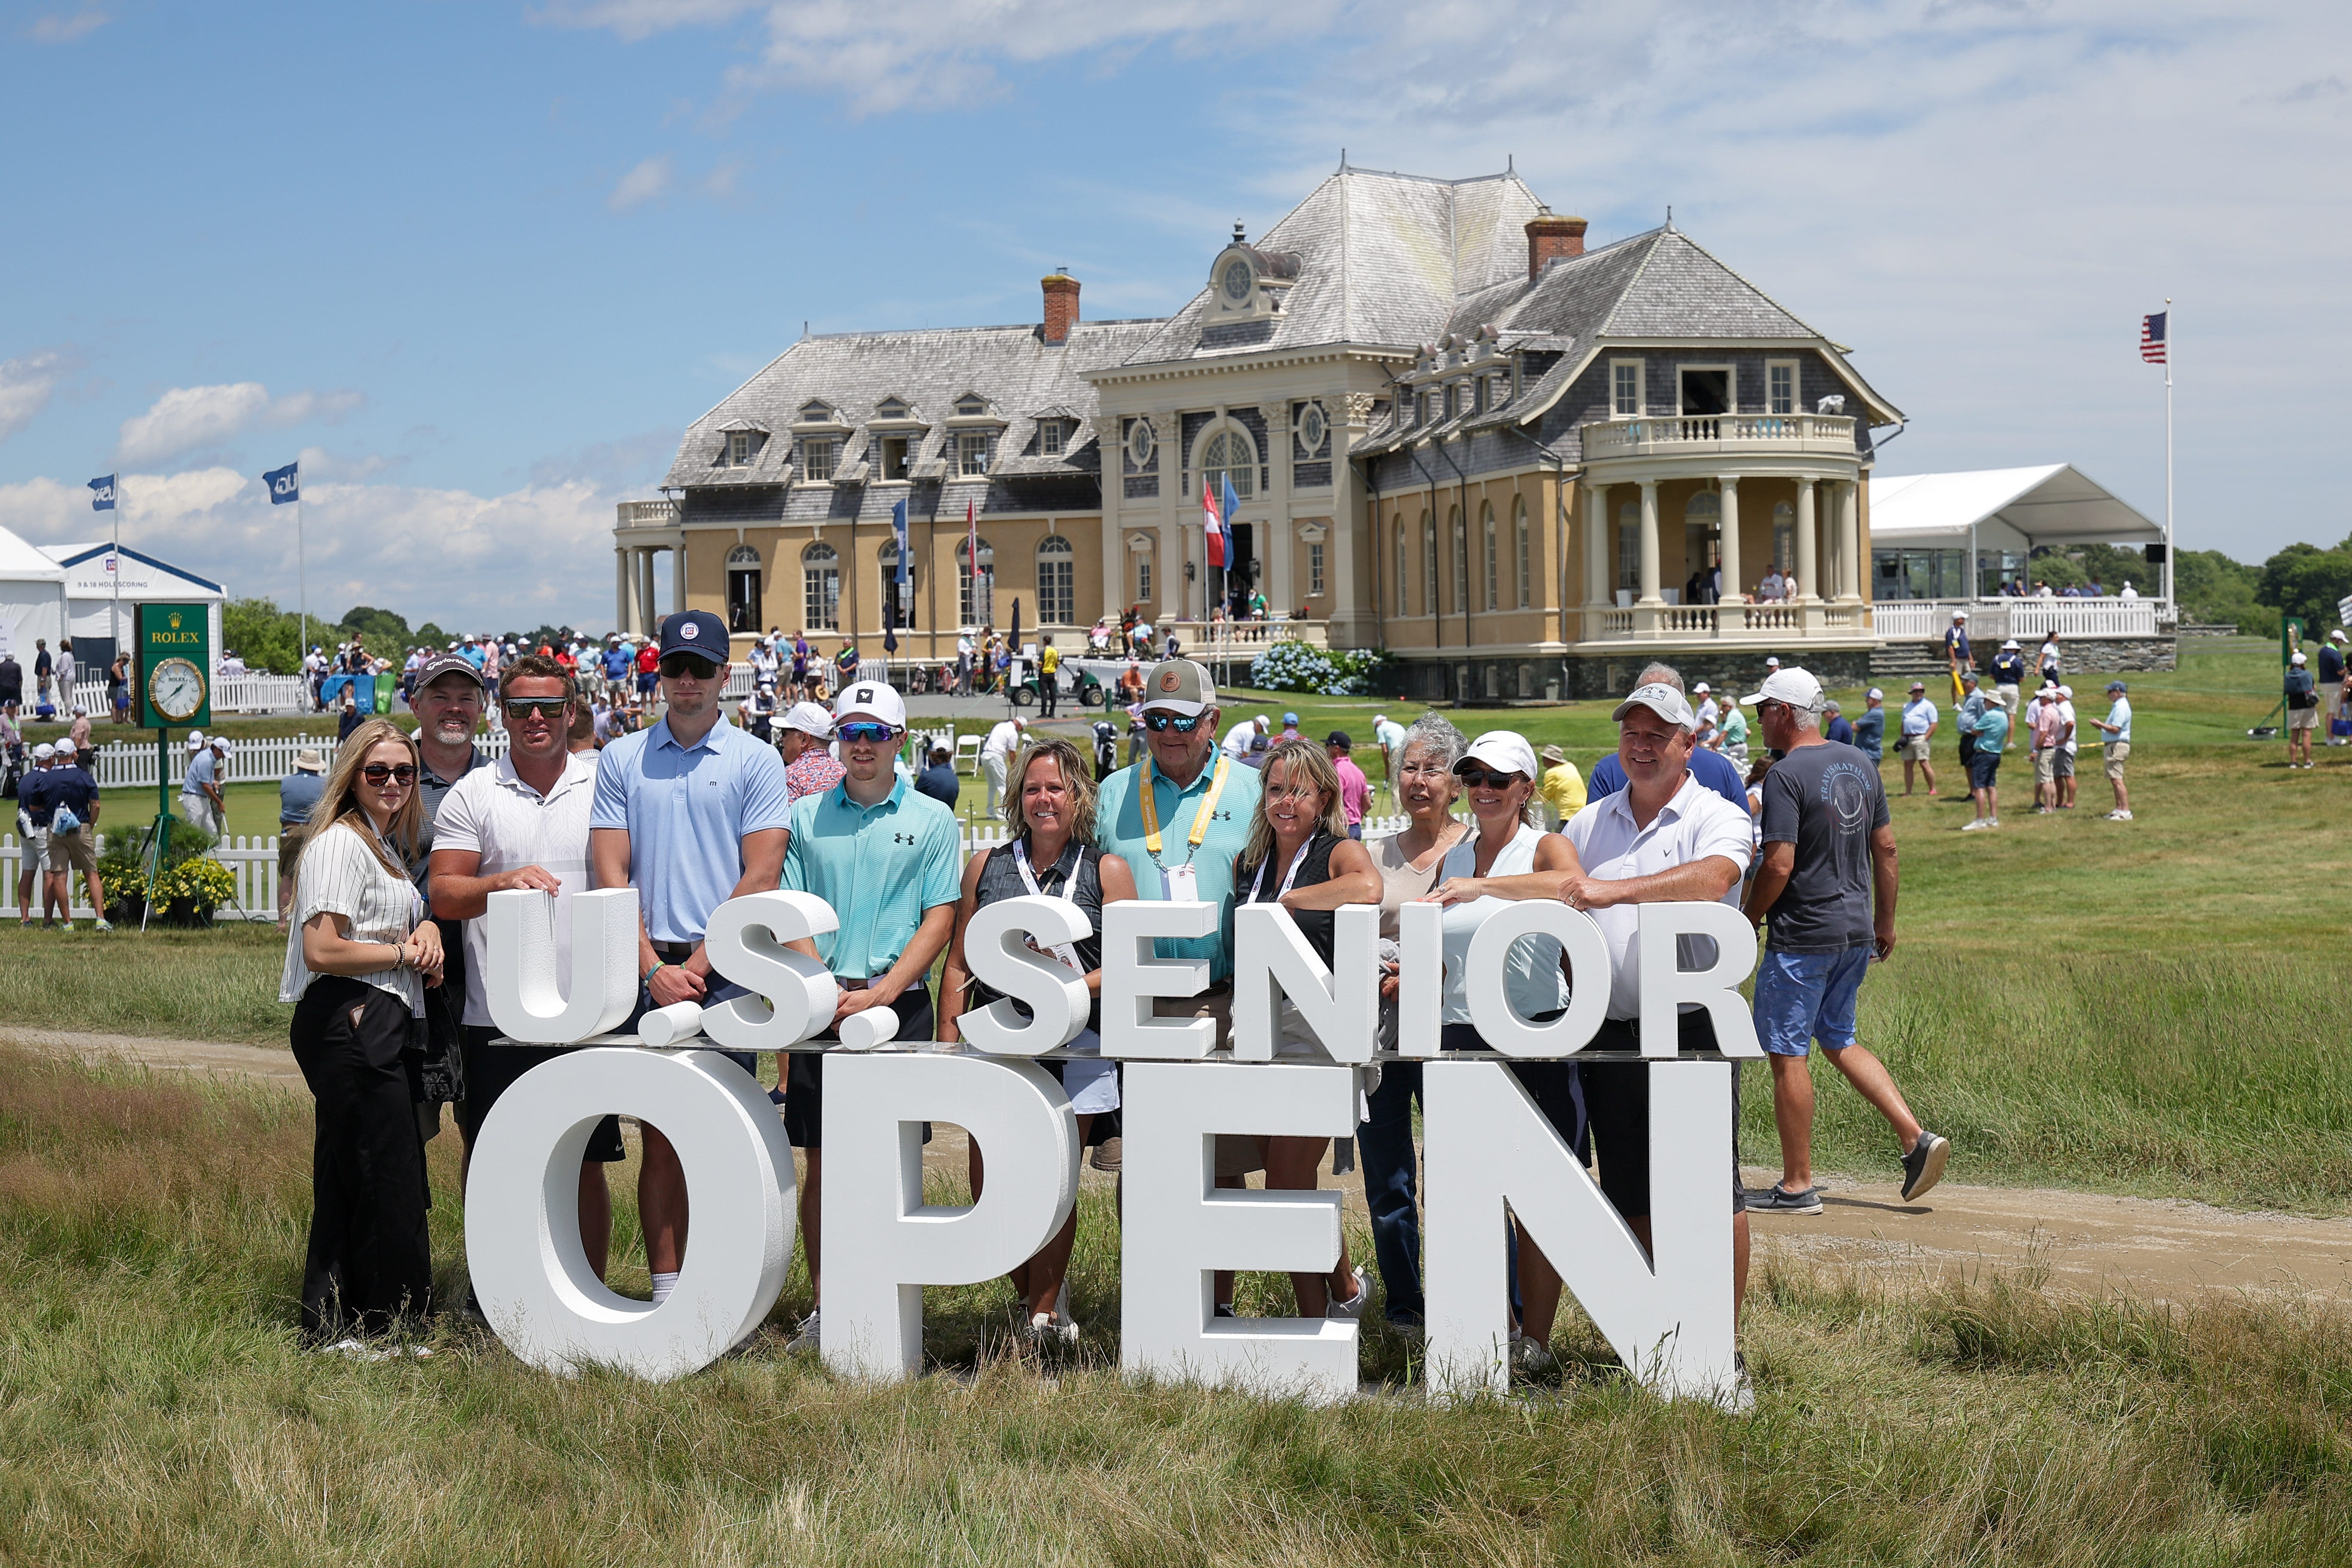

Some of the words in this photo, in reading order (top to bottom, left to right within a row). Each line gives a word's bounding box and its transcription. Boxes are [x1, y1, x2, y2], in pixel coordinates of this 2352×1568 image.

[151, 632, 199, 643] ROLEX
[426, 657, 475, 671] TaylorMade
[1821, 763, 1872, 802] TRAVISMATHEW
[487, 888, 900, 1051] U.S.
[956, 894, 1764, 1062] SENIOR
[465, 1047, 1736, 1400] OPEN
